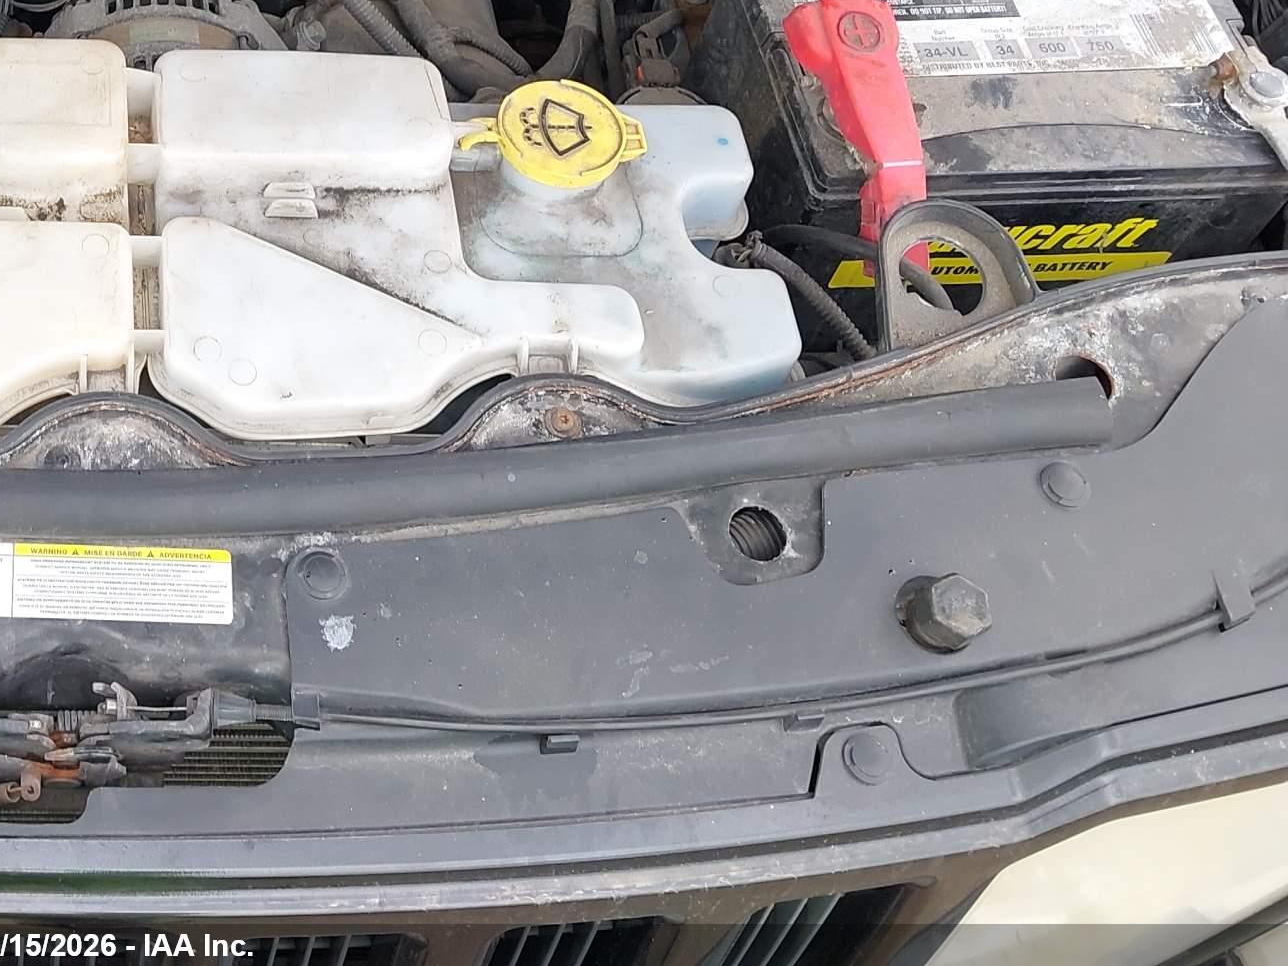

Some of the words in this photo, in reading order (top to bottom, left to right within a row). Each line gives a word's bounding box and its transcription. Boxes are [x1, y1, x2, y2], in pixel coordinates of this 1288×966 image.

[996, 44, 1015, 56] 34
[1086, 39, 1114, 51] 750
[923, 46, 969, 58] 34-VL
[1032, 261, 1113, 274] BATTERY
[30, 547, 68, 556] WARNING
[84, 549, 103, 557] MISE
[116, 550, 143, 558] GARDE
[159, 551, 213, 561] ADVERTENCIA
